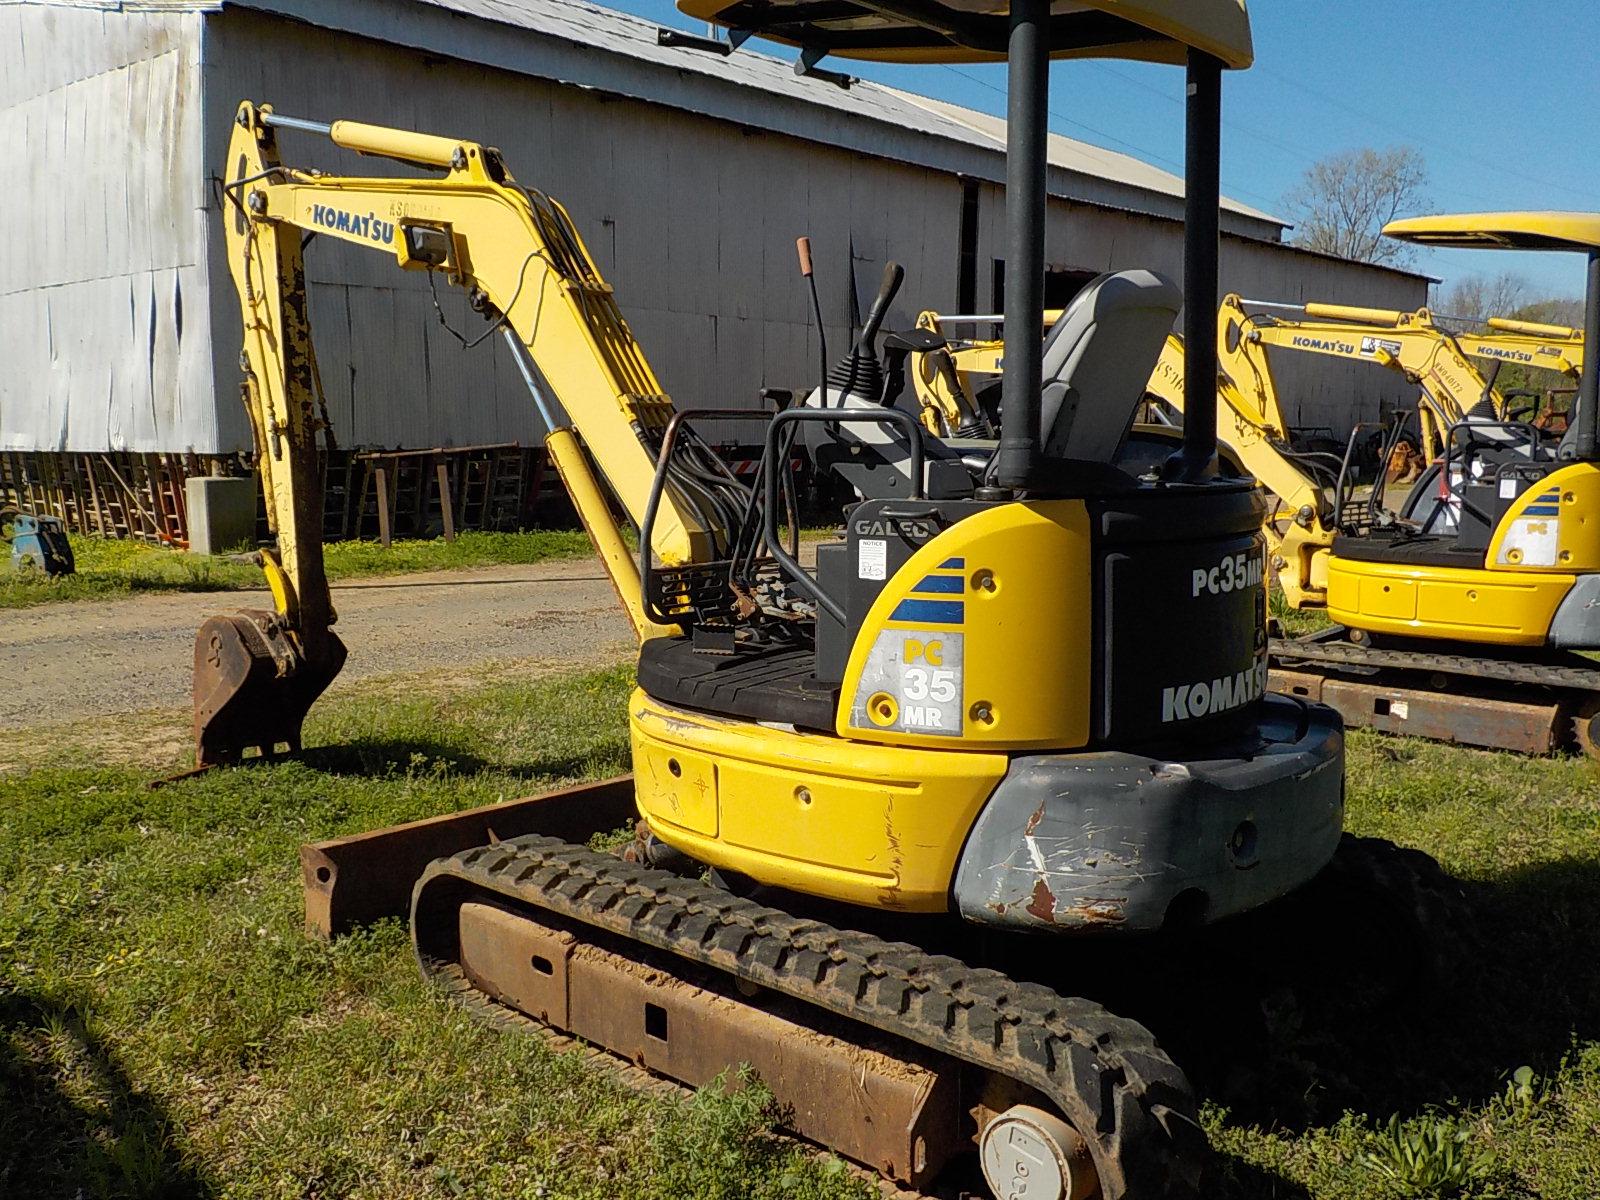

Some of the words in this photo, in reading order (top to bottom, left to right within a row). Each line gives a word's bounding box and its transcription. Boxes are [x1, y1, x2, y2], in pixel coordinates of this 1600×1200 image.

[313, 203, 394, 245] KOMATSU
[1292, 336, 1355, 355] KOMATSU
[1477, 345, 1533, 362] KOMATSU
[855, 520, 930, 538] GALEO
[903, 639, 944, 666] PC
[903, 668, 956, 703] 35
[903, 705, 943, 727] MR
